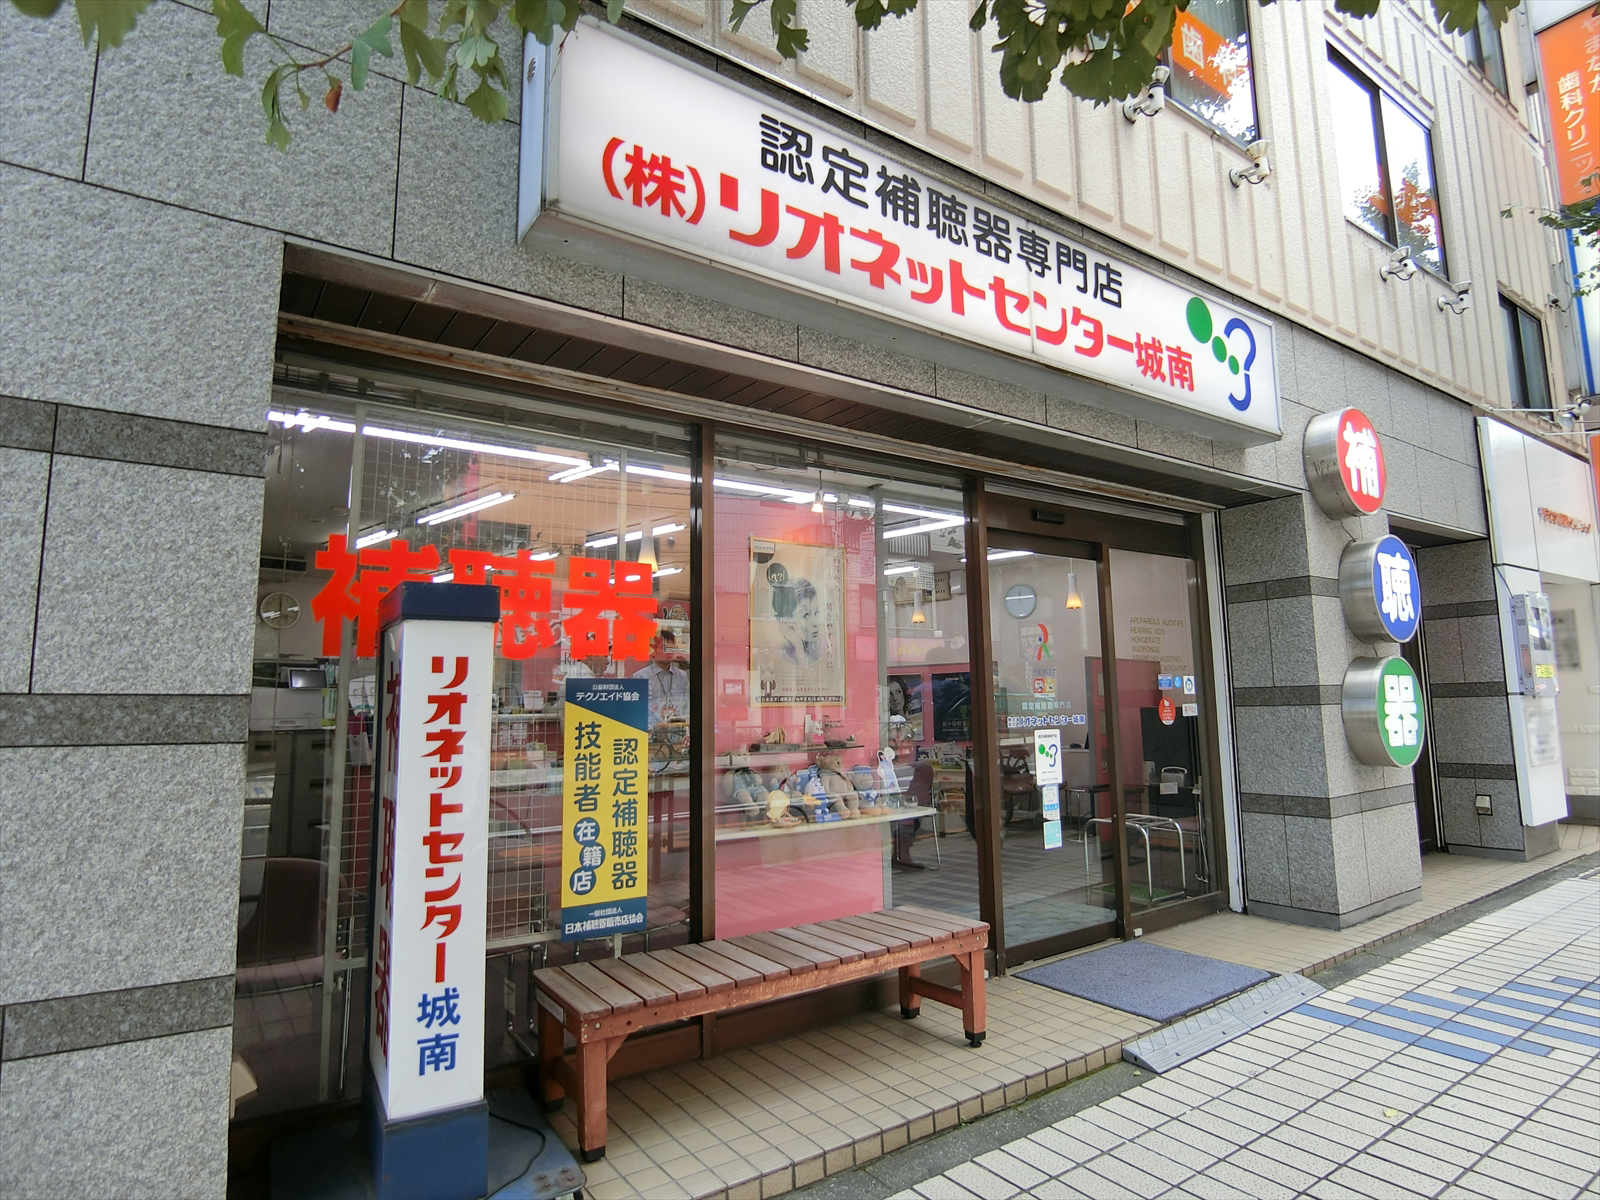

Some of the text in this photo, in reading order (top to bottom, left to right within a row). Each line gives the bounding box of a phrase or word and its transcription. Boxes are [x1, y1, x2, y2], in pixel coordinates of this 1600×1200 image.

[759, 113, 1123, 308] 認定補聴器専門店
[1343, 421, 1380, 498] 補
[311, 534, 658, 661] 補聴器
[576, 691, 640, 702] テクノエイド協会
[1384, 674, 1419, 747] 器
[611, 737, 639, 890] 認定補聴器
[416, 656, 470, 1076] リオネットセンター城南
[565, 912, 644, 935] 日本補聴器販売店協会
[589, 907, 623, 917] 一般社団法人
